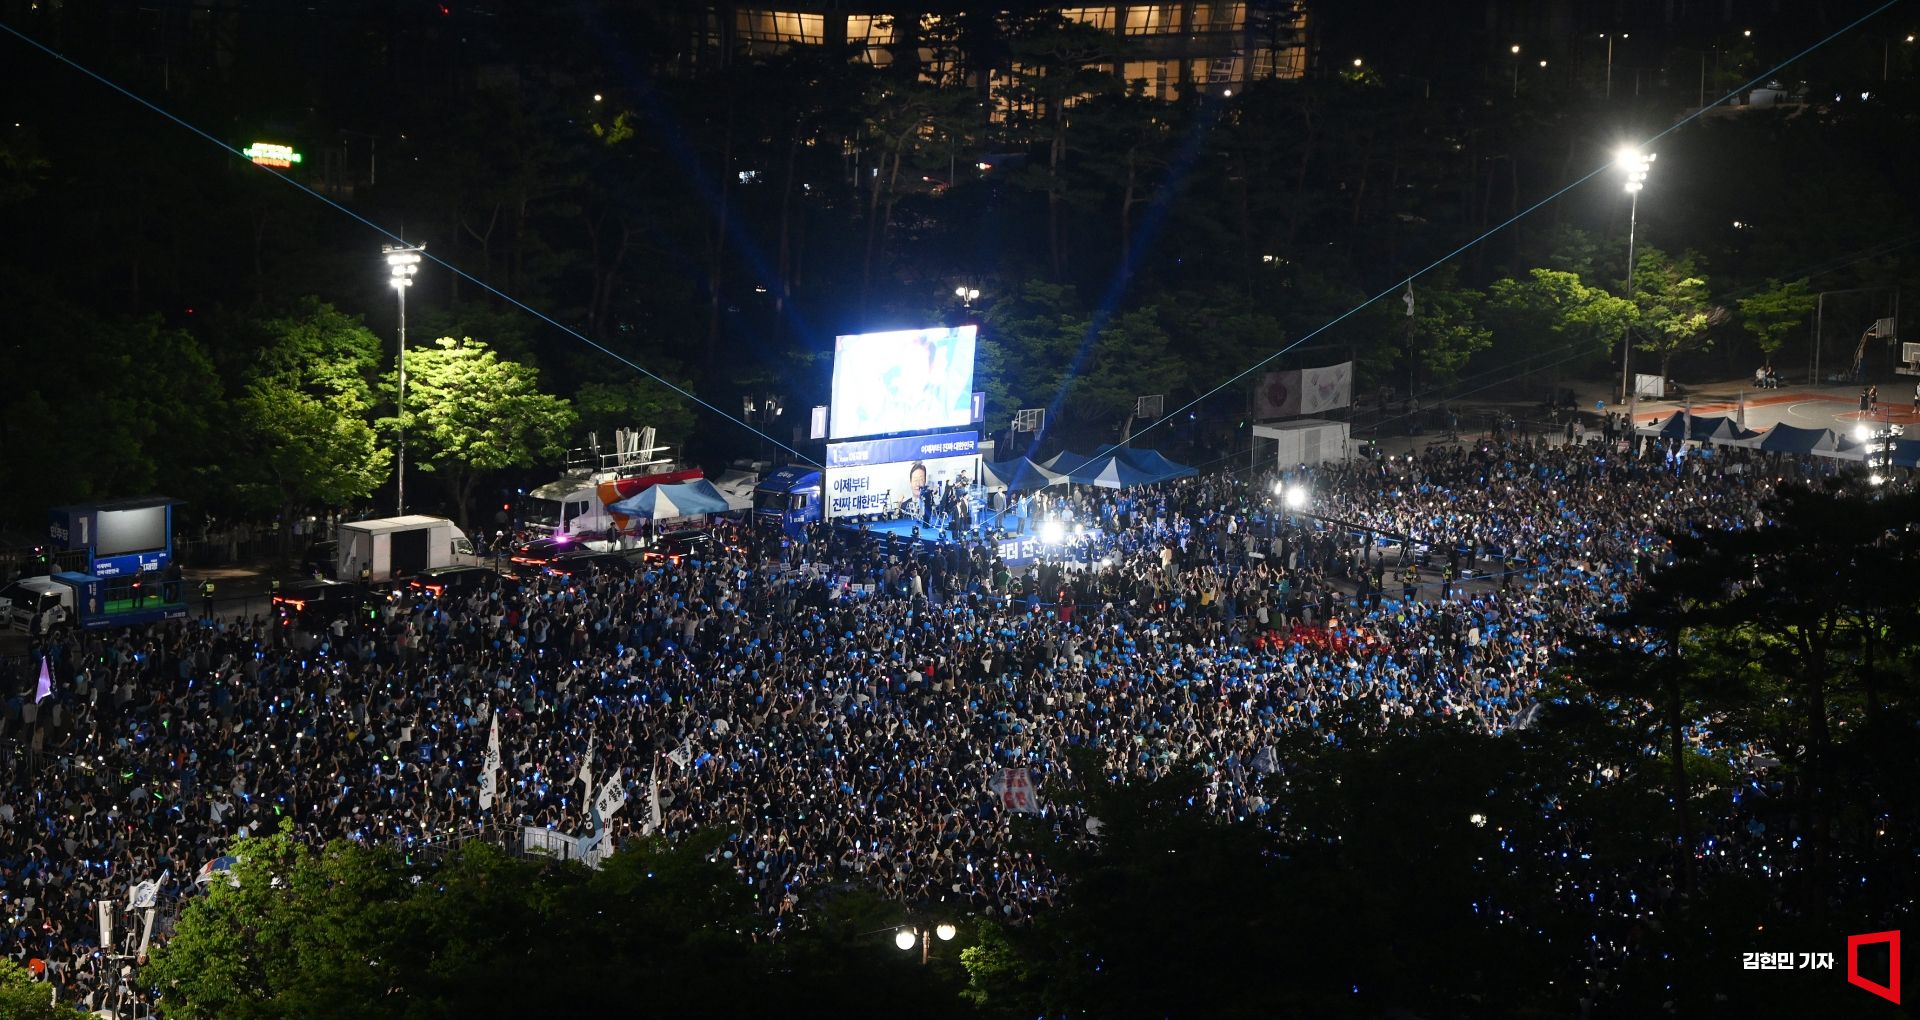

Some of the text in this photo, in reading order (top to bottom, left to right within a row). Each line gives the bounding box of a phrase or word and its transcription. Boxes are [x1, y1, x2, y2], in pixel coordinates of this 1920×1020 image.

[973, 395, 980, 419] 1
[817, 410, 825, 434] 1
[832, 449, 838, 463] 1
[833, 476, 870, 493] 이제부터
[832, 492, 889, 512] 진짜 대한민국
[79, 516, 88, 544] 1
